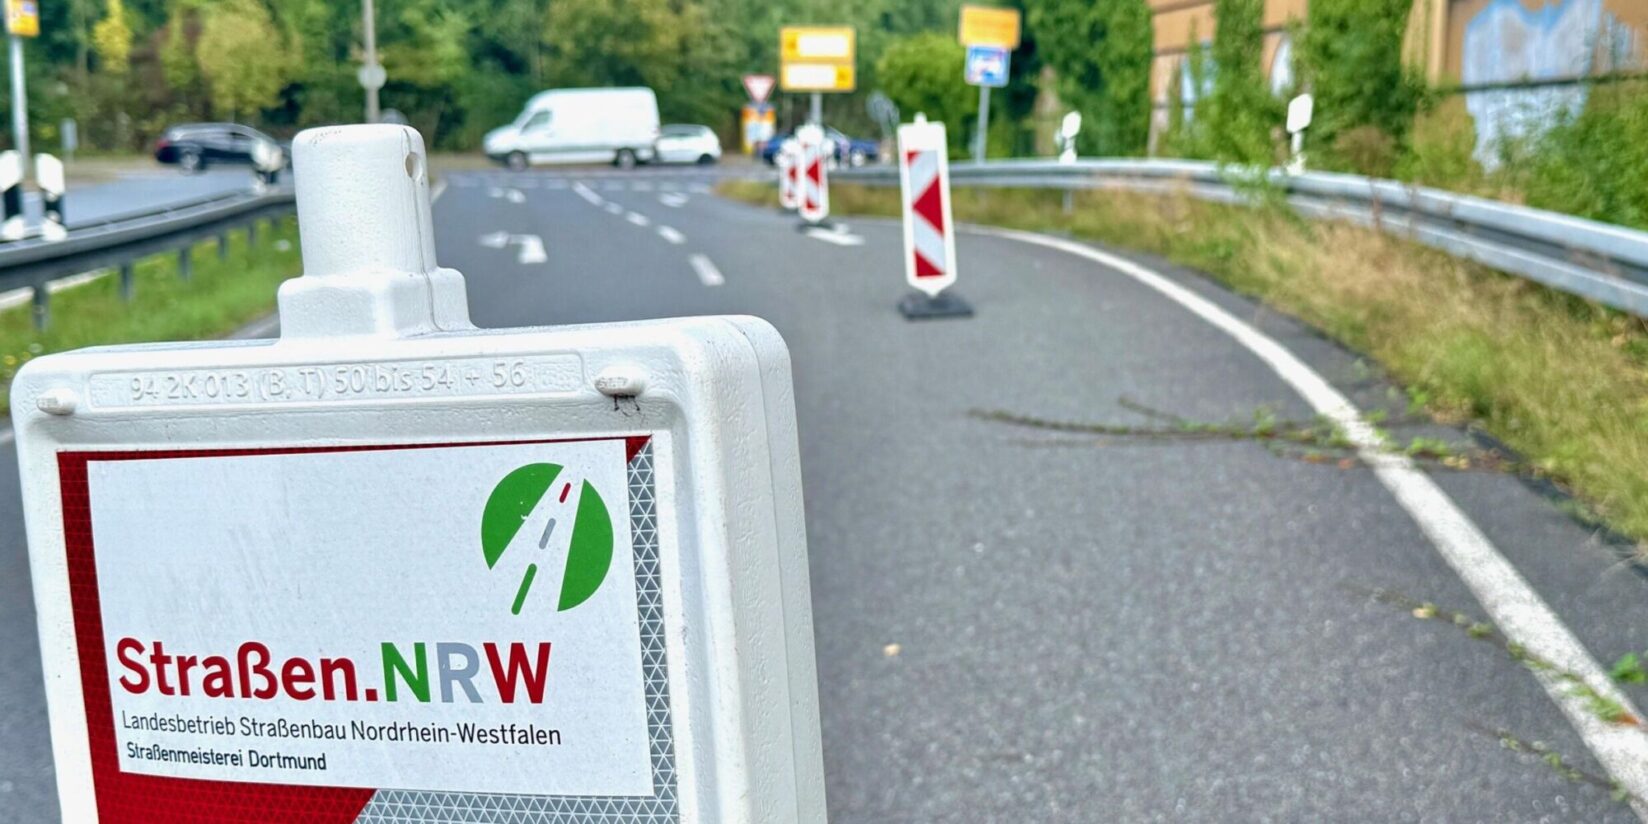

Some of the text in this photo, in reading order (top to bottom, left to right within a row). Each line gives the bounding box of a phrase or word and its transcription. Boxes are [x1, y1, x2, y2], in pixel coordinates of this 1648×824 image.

[131, 376, 159, 401] 94
[335, 366, 366, 394] 50
[374, 364, 413, 393] bis
[421, 362, 455, 391] 54
[493, 358, 527, 388] 56
[116, 637, 552, 704] Straßen.NRW
[122, 711, 562, 746] Landesbetrieb Straßenbau Nordrhein-Westfalen
[127, 741, 327, 771] Straßenmeisterei Dortmund
